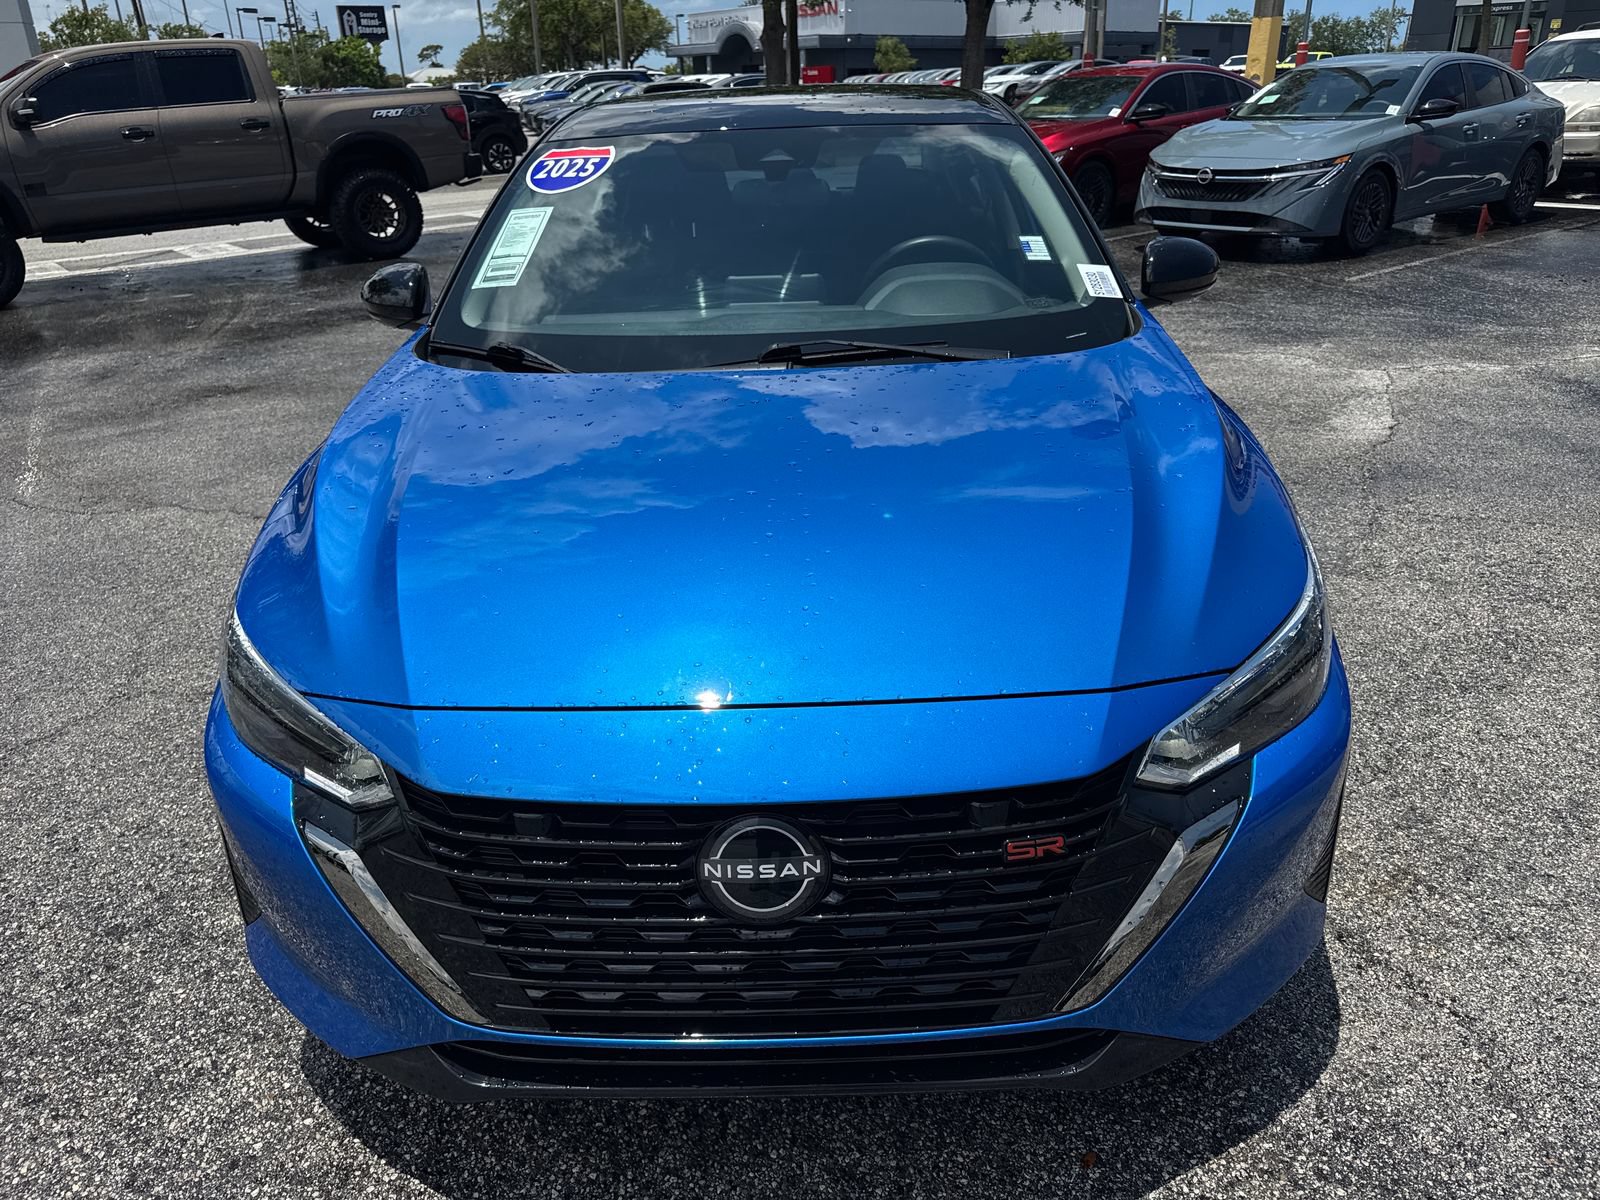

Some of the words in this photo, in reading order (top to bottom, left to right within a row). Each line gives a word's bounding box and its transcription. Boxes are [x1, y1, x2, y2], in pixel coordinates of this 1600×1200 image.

[358, 26, 386, 34] Storage
[533, 157, 601, 179] 2025
[1007, 836, 1066, 860] SR
[703, 859, 821, 879] NISSAN
